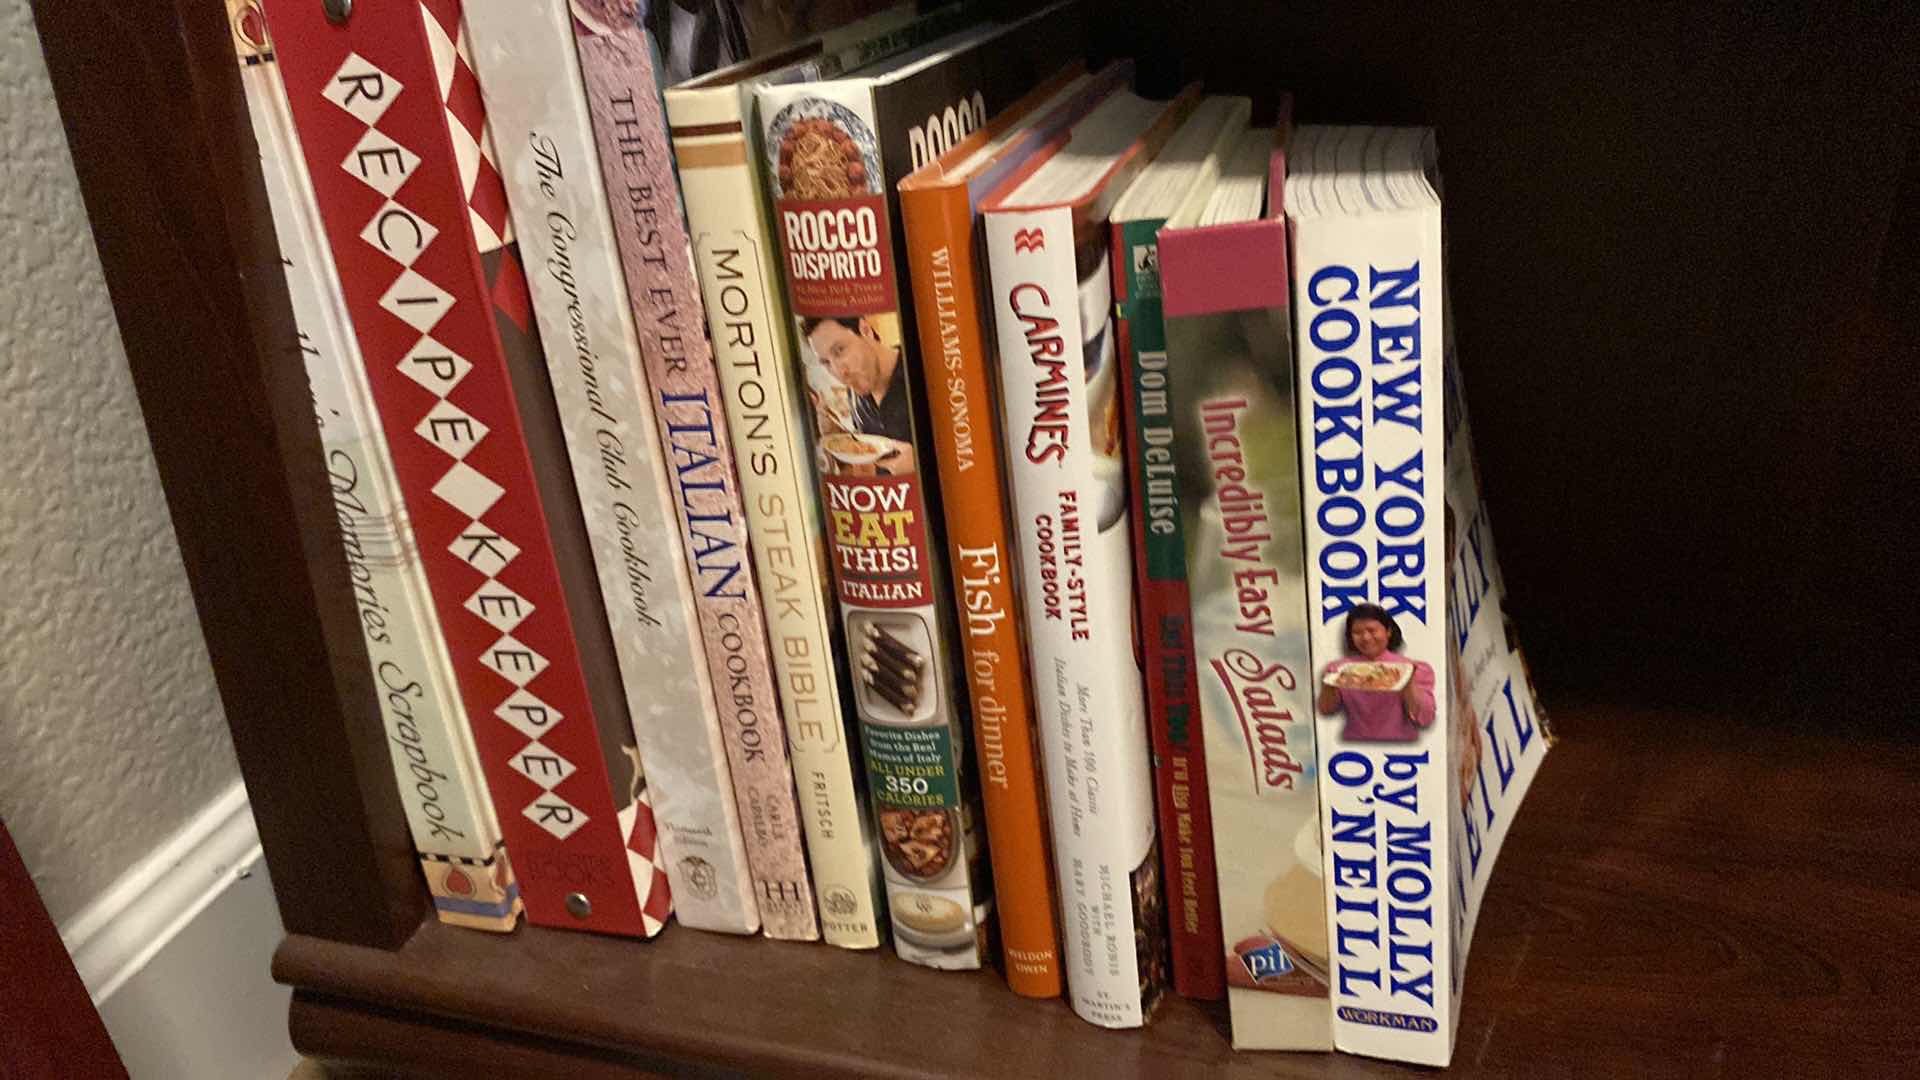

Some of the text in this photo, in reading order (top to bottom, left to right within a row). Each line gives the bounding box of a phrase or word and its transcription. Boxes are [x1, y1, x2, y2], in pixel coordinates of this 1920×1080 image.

[784, 206, 878, 252] ROCCO
[791, 249, 882, 281] DISPIRITO
[527, 130, 662, 629] The Congressional Club Cookbook
[930, 245, 975, 473] WILLIAMS-SONOMA
[338, 71, 474, 443] RECIPE
[461, 531, 574, 826] KEEPER
[610, 87, 765, 764] THE BEST EVER ITALIAN COOKBOOK
[1138, 350, 1178, 537] Dom DeLuise
[1307, 264, 1369, 626] COOKBOOK
[1368, 258, 1428, 626] NEW YORK
[710, 247, 825, 743] MORTON'S STEAK BIBLE
[827, 482, 910, 513] NOW
[831, 510, 915, 547] EAT
[1201, 398, 1279, 640] Incredibly Easy
[835, 543, 918, 574] THIS!
[842, 581, 924, 602] ITALIAN
[1035, 513, 1062, 621] COOKBOOK
[1058, 490, 1090, 642] FAMILY-STYLE
[958, 541, 1009, 789] Fish for dinner
[1223, 647, 1304, 792] Salads
[377, 660, 465, 843] Scrapbook
[870, 760, 944, 777] ALL UNDER
[876, 789, 944, 808] CALORIES
[885, 775, 929, 795] 350
[893, 741, 912, 752] the
[912, 741, 937, 753] Real
[903, 730, 941, 742] Dishes
[916, 752, 942, 765] Italy
[811, 771, 835, 840] FRITSCH
[1327, 750, 1383, 998] O'NEILL
[1373, 750, 1434, 1008] by MOLLY
[1339, 1007, 1435, 1031] WORKMAN
